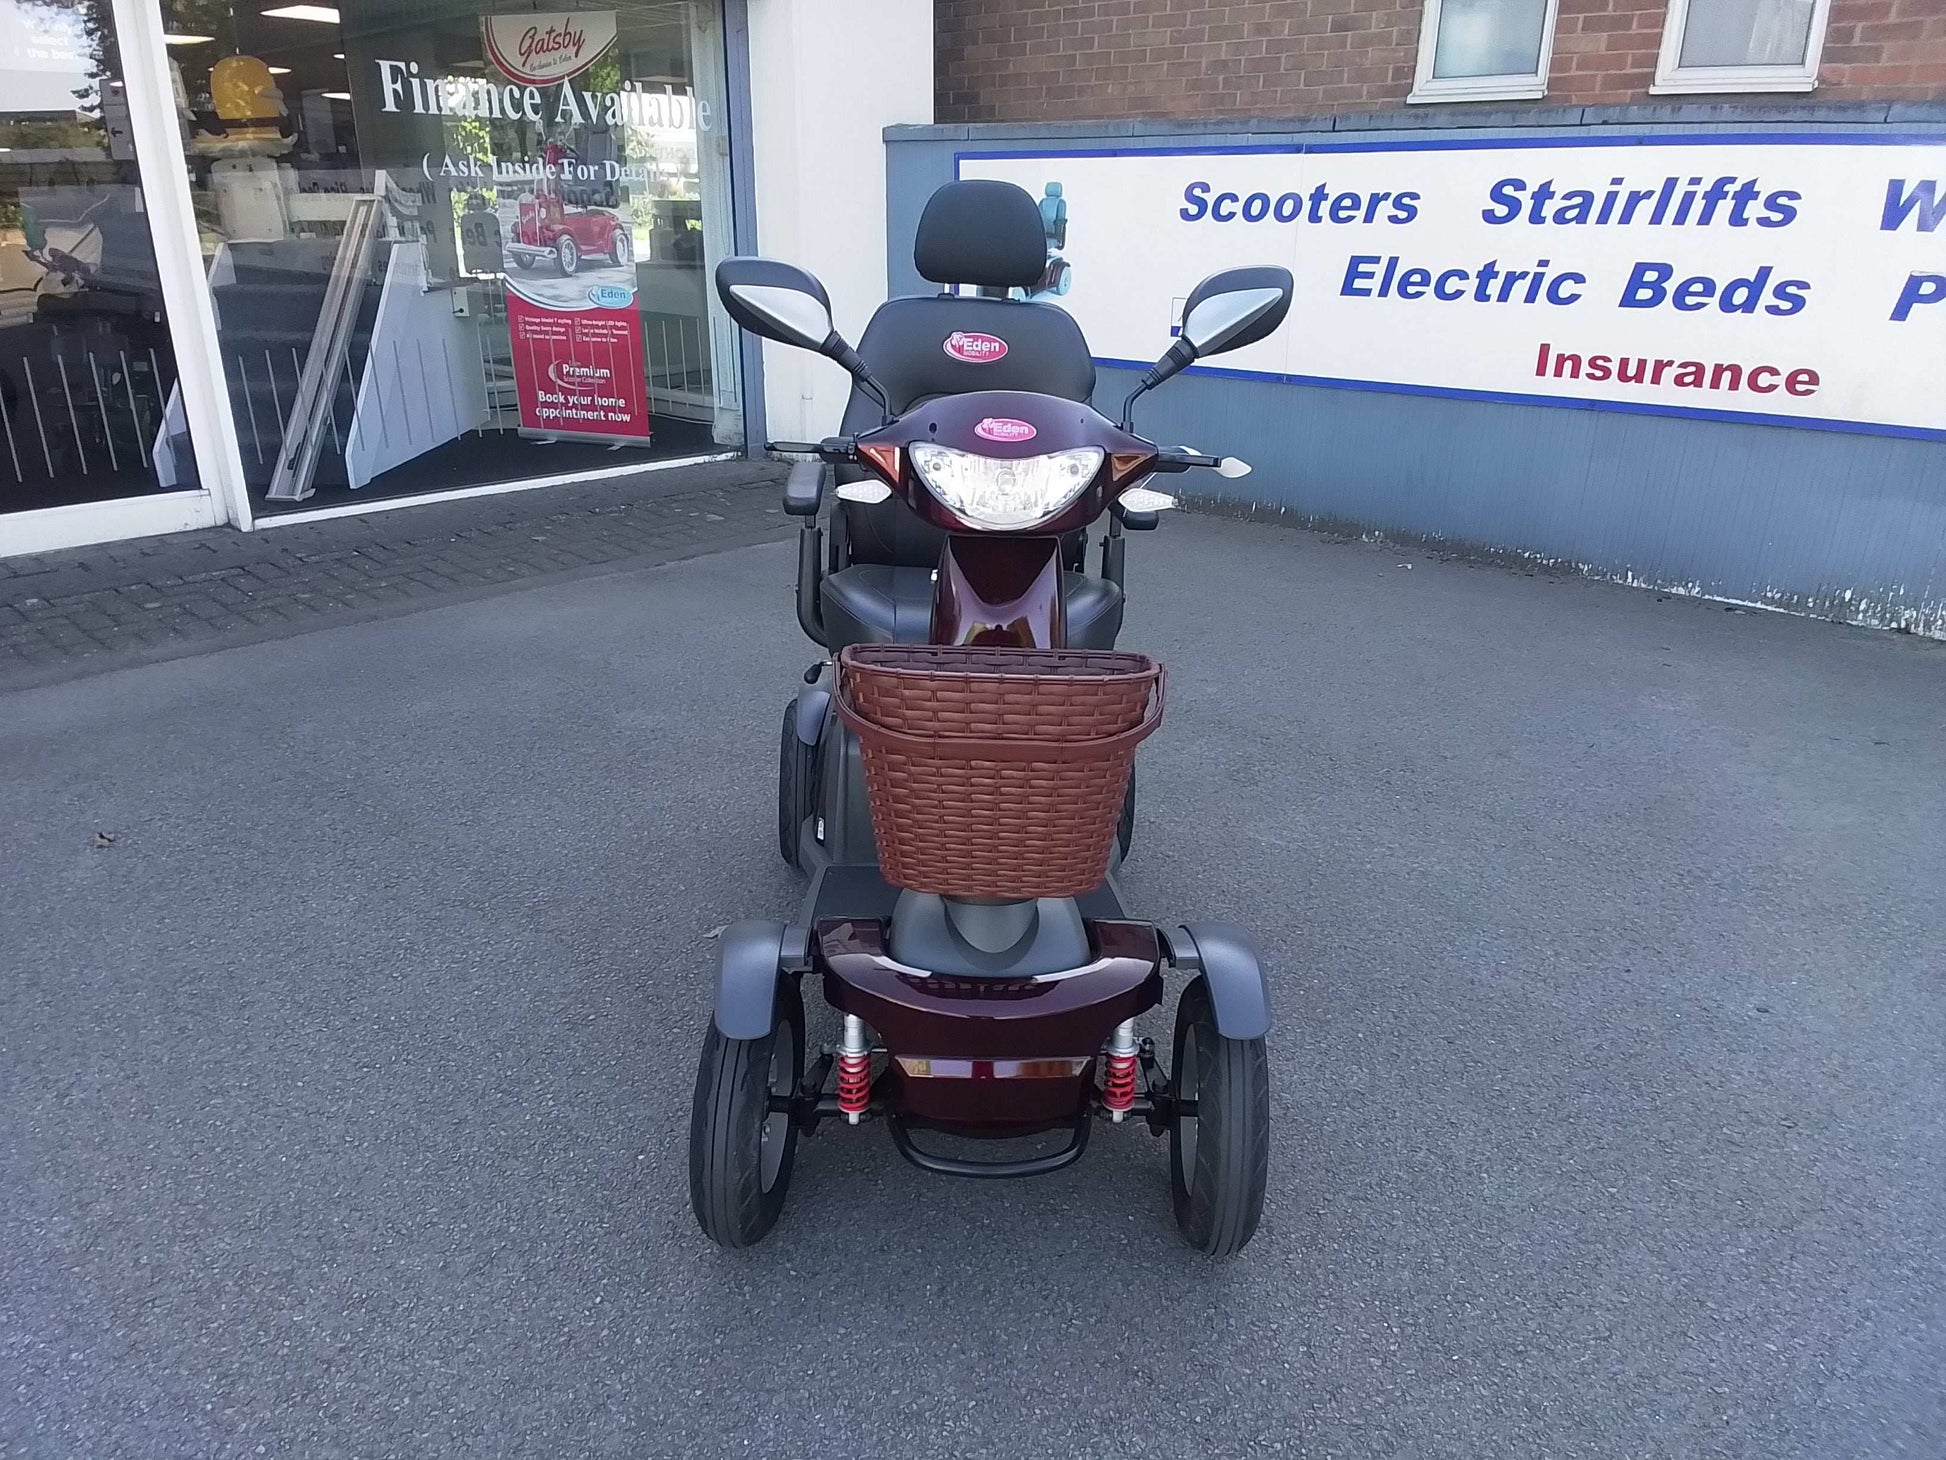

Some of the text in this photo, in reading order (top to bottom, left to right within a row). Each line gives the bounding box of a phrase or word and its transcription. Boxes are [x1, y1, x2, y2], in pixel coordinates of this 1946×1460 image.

[518, 16, 586, 68] Gatsby
[375, 58, 713, 132] Finance Available
[439, 155, 485, 179] Ask
[492, 156, 557, 181] Inside
[560, 158, 600, 181] For
[1179, 180, 1422, 226] Scooters
[1480, 175, 1803, 229] Stairlifts
[600, 288, 626, 299] Eden
[1339, 254, 1588, 306] Electric
[1617, 260, 1812, 318] Beds
[963, 338, 1000, 352] Eden
[562, 363, 611, 378] Premium
[1534, 342, 1822, 398] Insurance
[537, 390, 626, 407] Book your home
[535, 407, 632, 423] appointment now
[993, 422, 1029, 434] Eden
